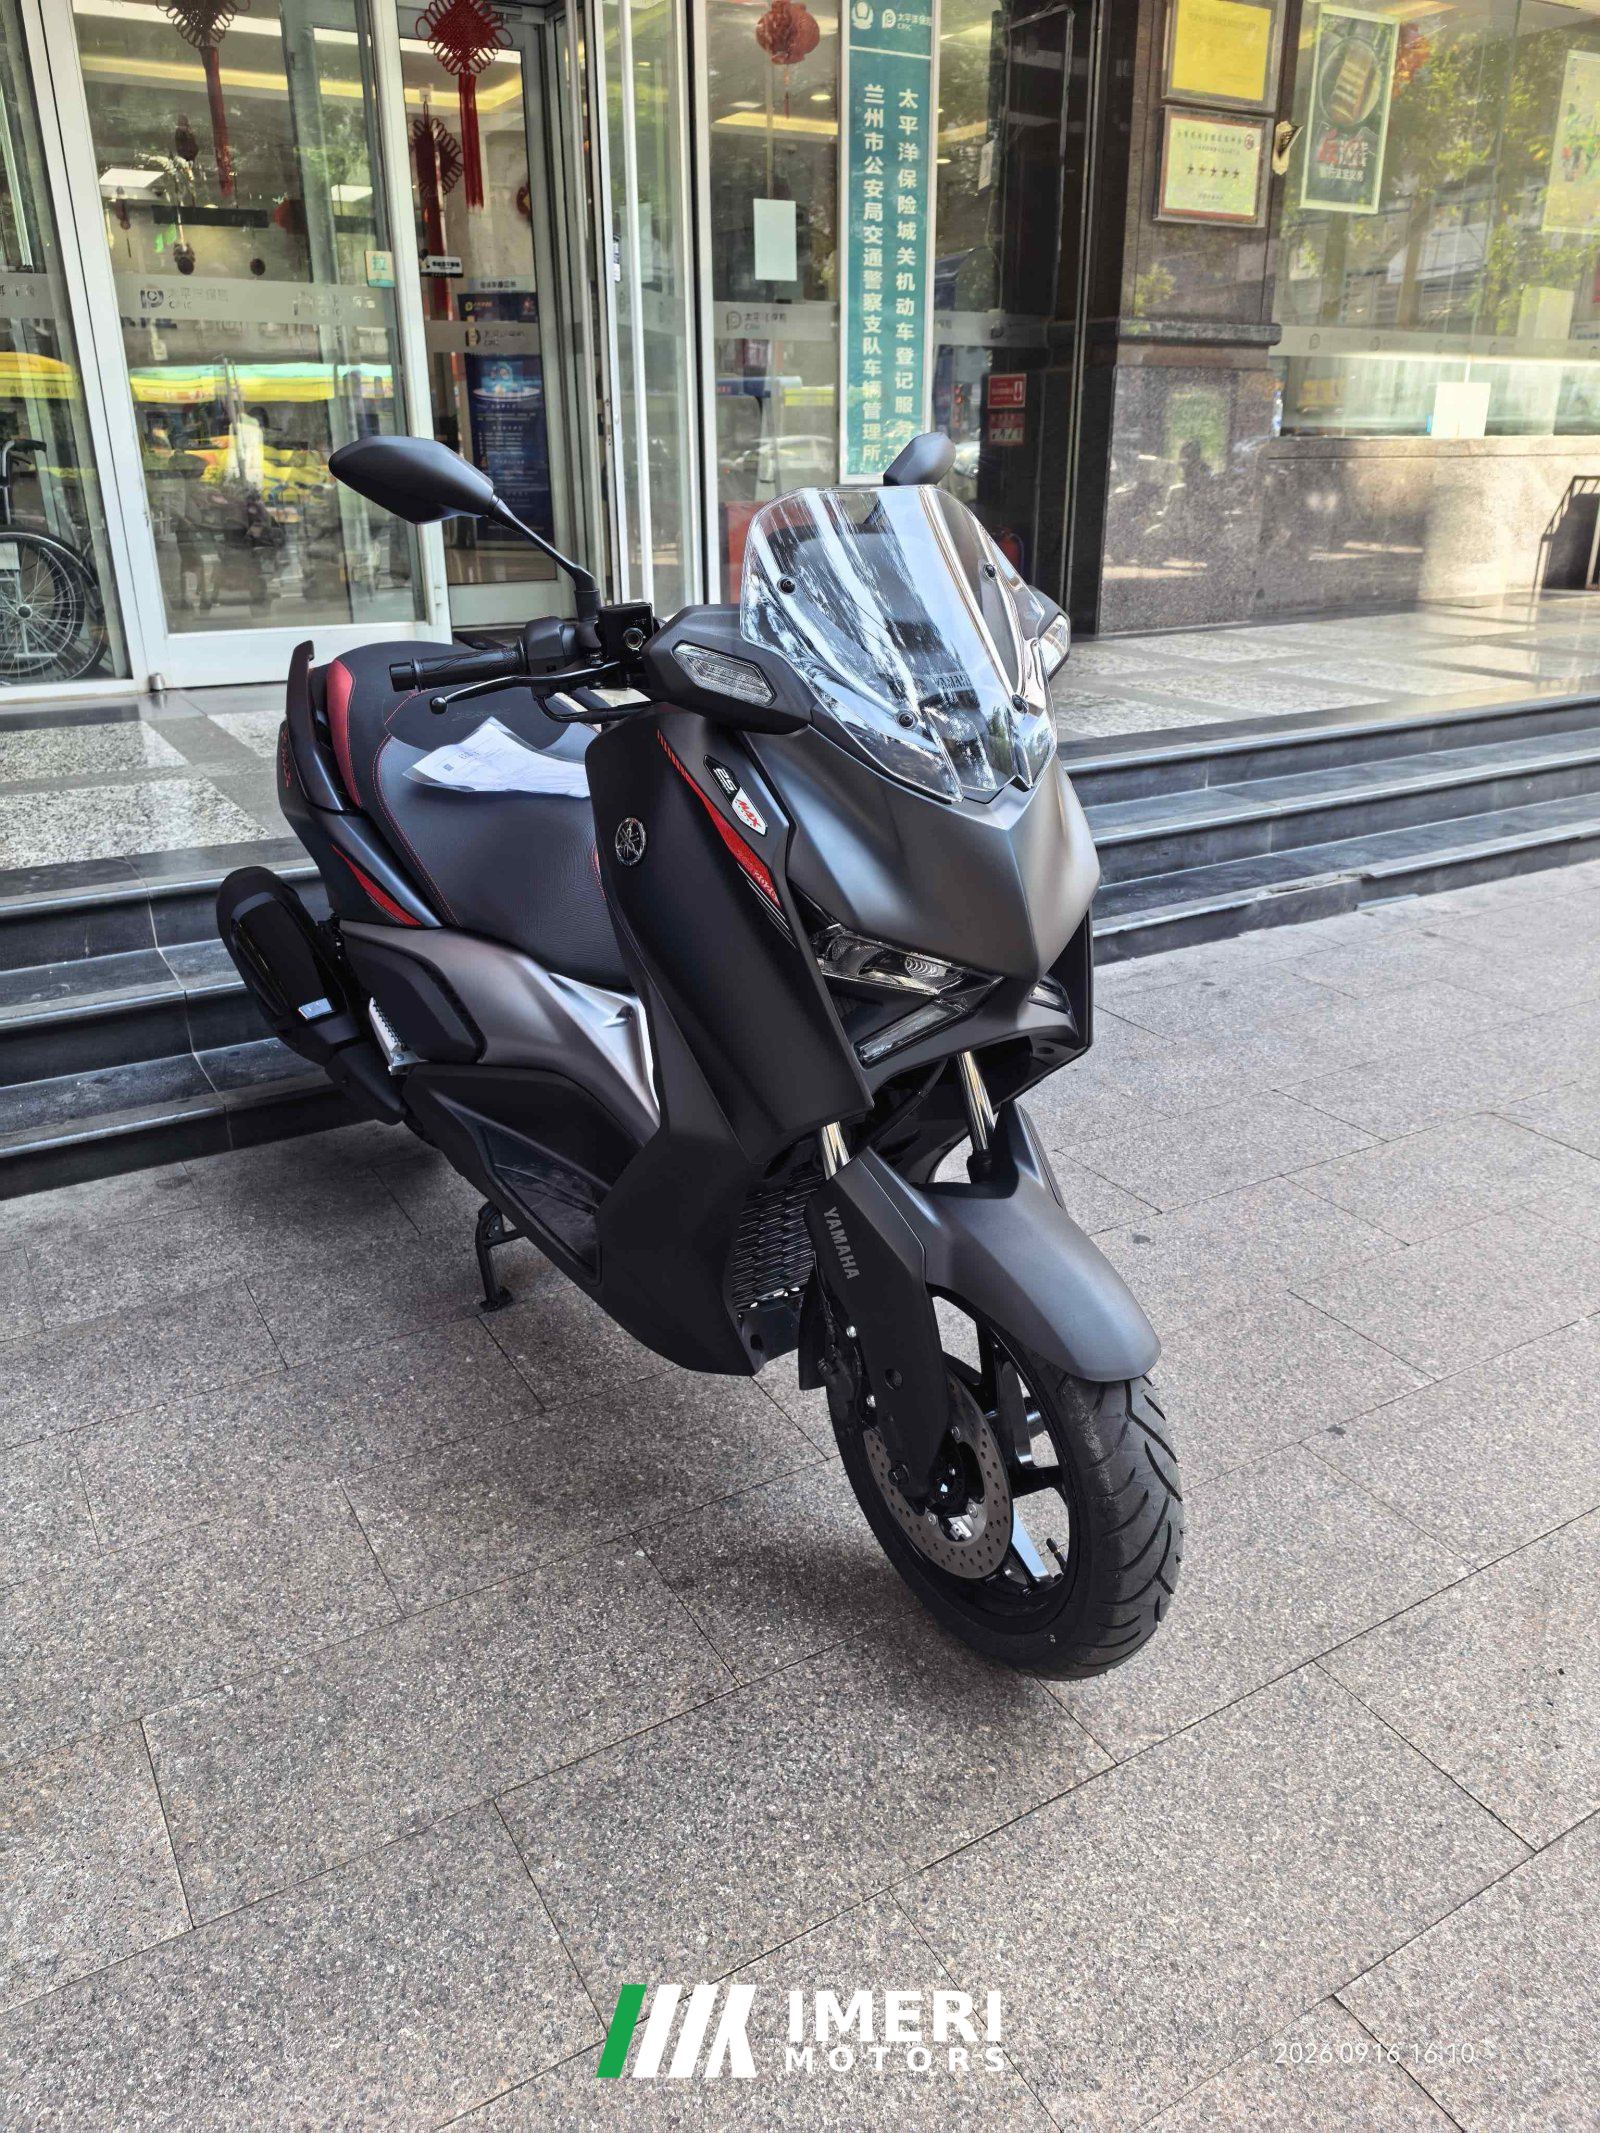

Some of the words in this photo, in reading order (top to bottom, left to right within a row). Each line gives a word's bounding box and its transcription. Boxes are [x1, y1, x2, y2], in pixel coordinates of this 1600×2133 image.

[862, 83, 885, 462] 兰州市公安局交通警察支队车辆管理所
[894, 88, 919, 457] 太平洋保险城关机动车登记服务
[823, 1206, 860, 1280] YAMAHA
